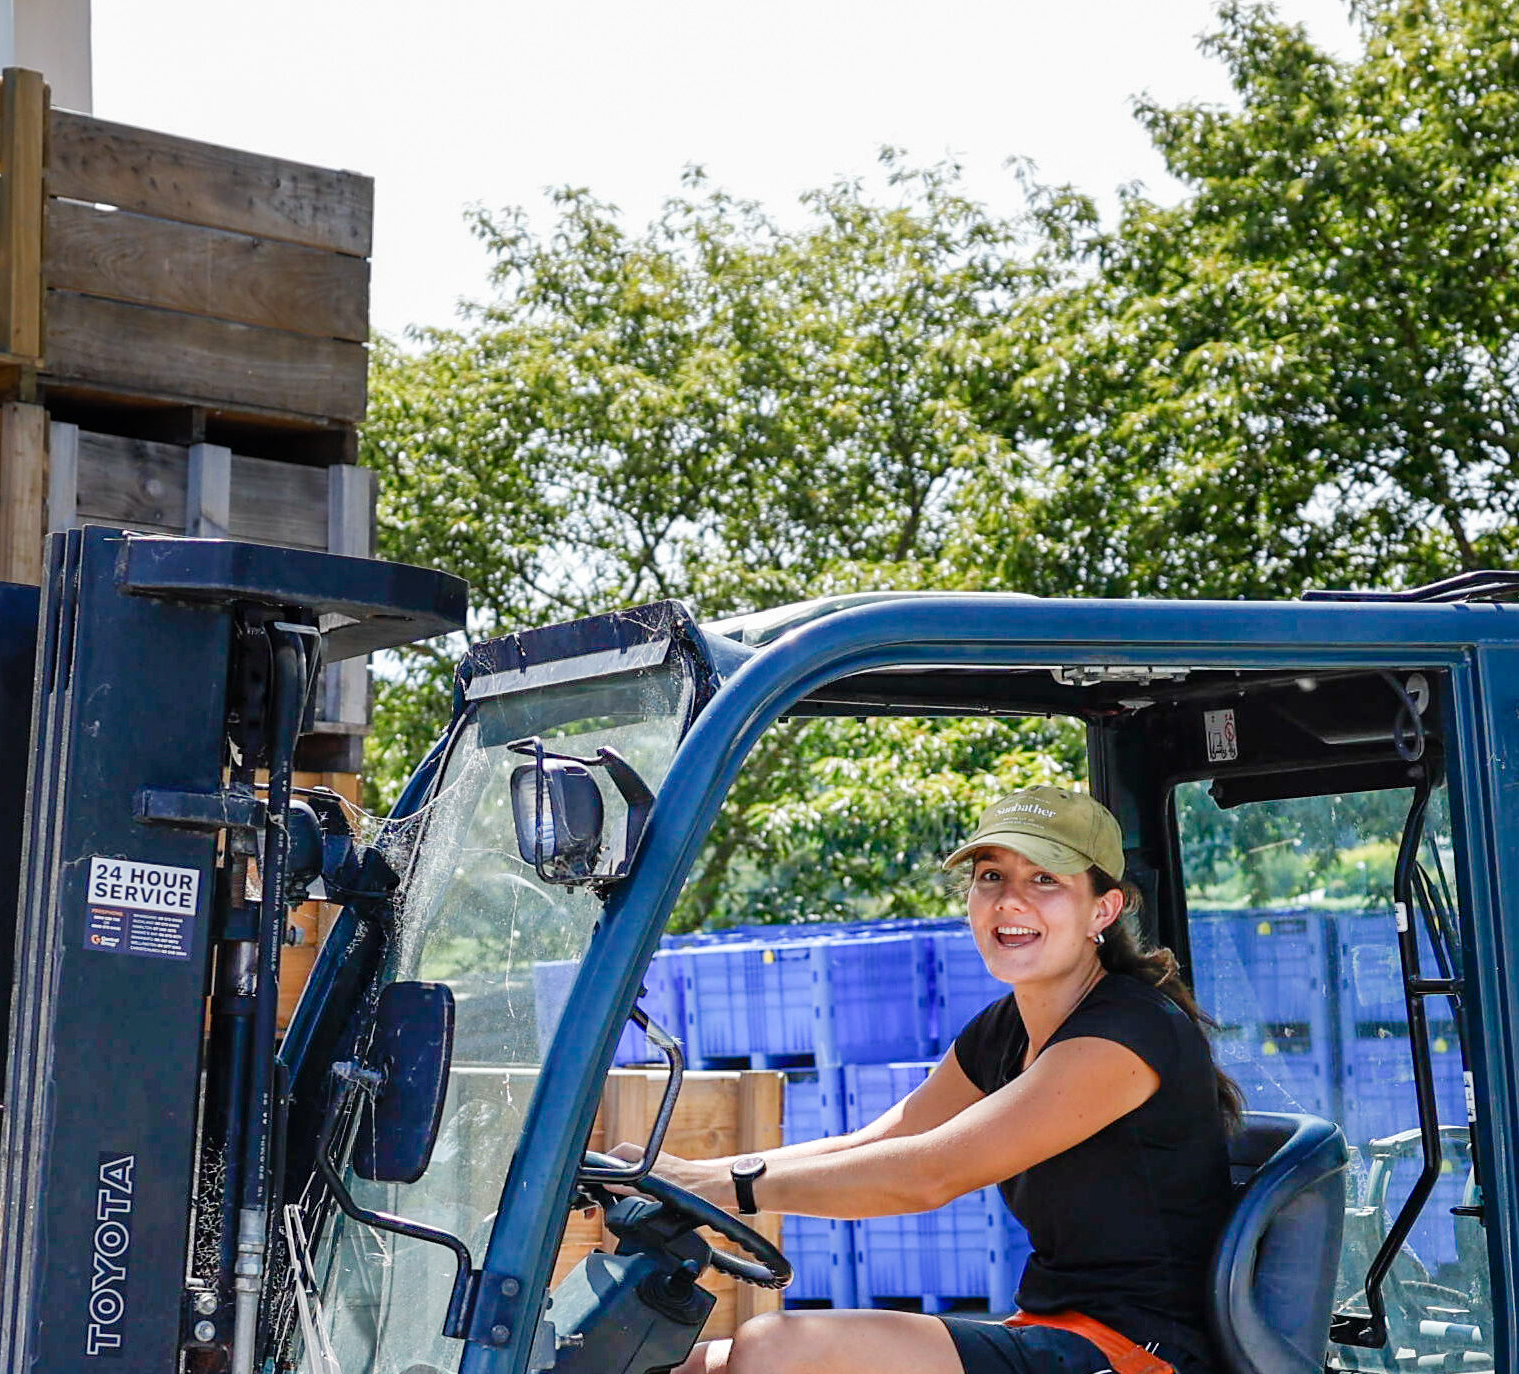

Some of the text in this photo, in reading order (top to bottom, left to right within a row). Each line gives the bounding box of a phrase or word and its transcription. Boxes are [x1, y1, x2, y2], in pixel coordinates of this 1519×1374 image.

[96, 864, 193, 890] 24 HOUR
[94, 882, 192, 908] SERVICE
[86, 1155, 134, 1356] TOYOTA
